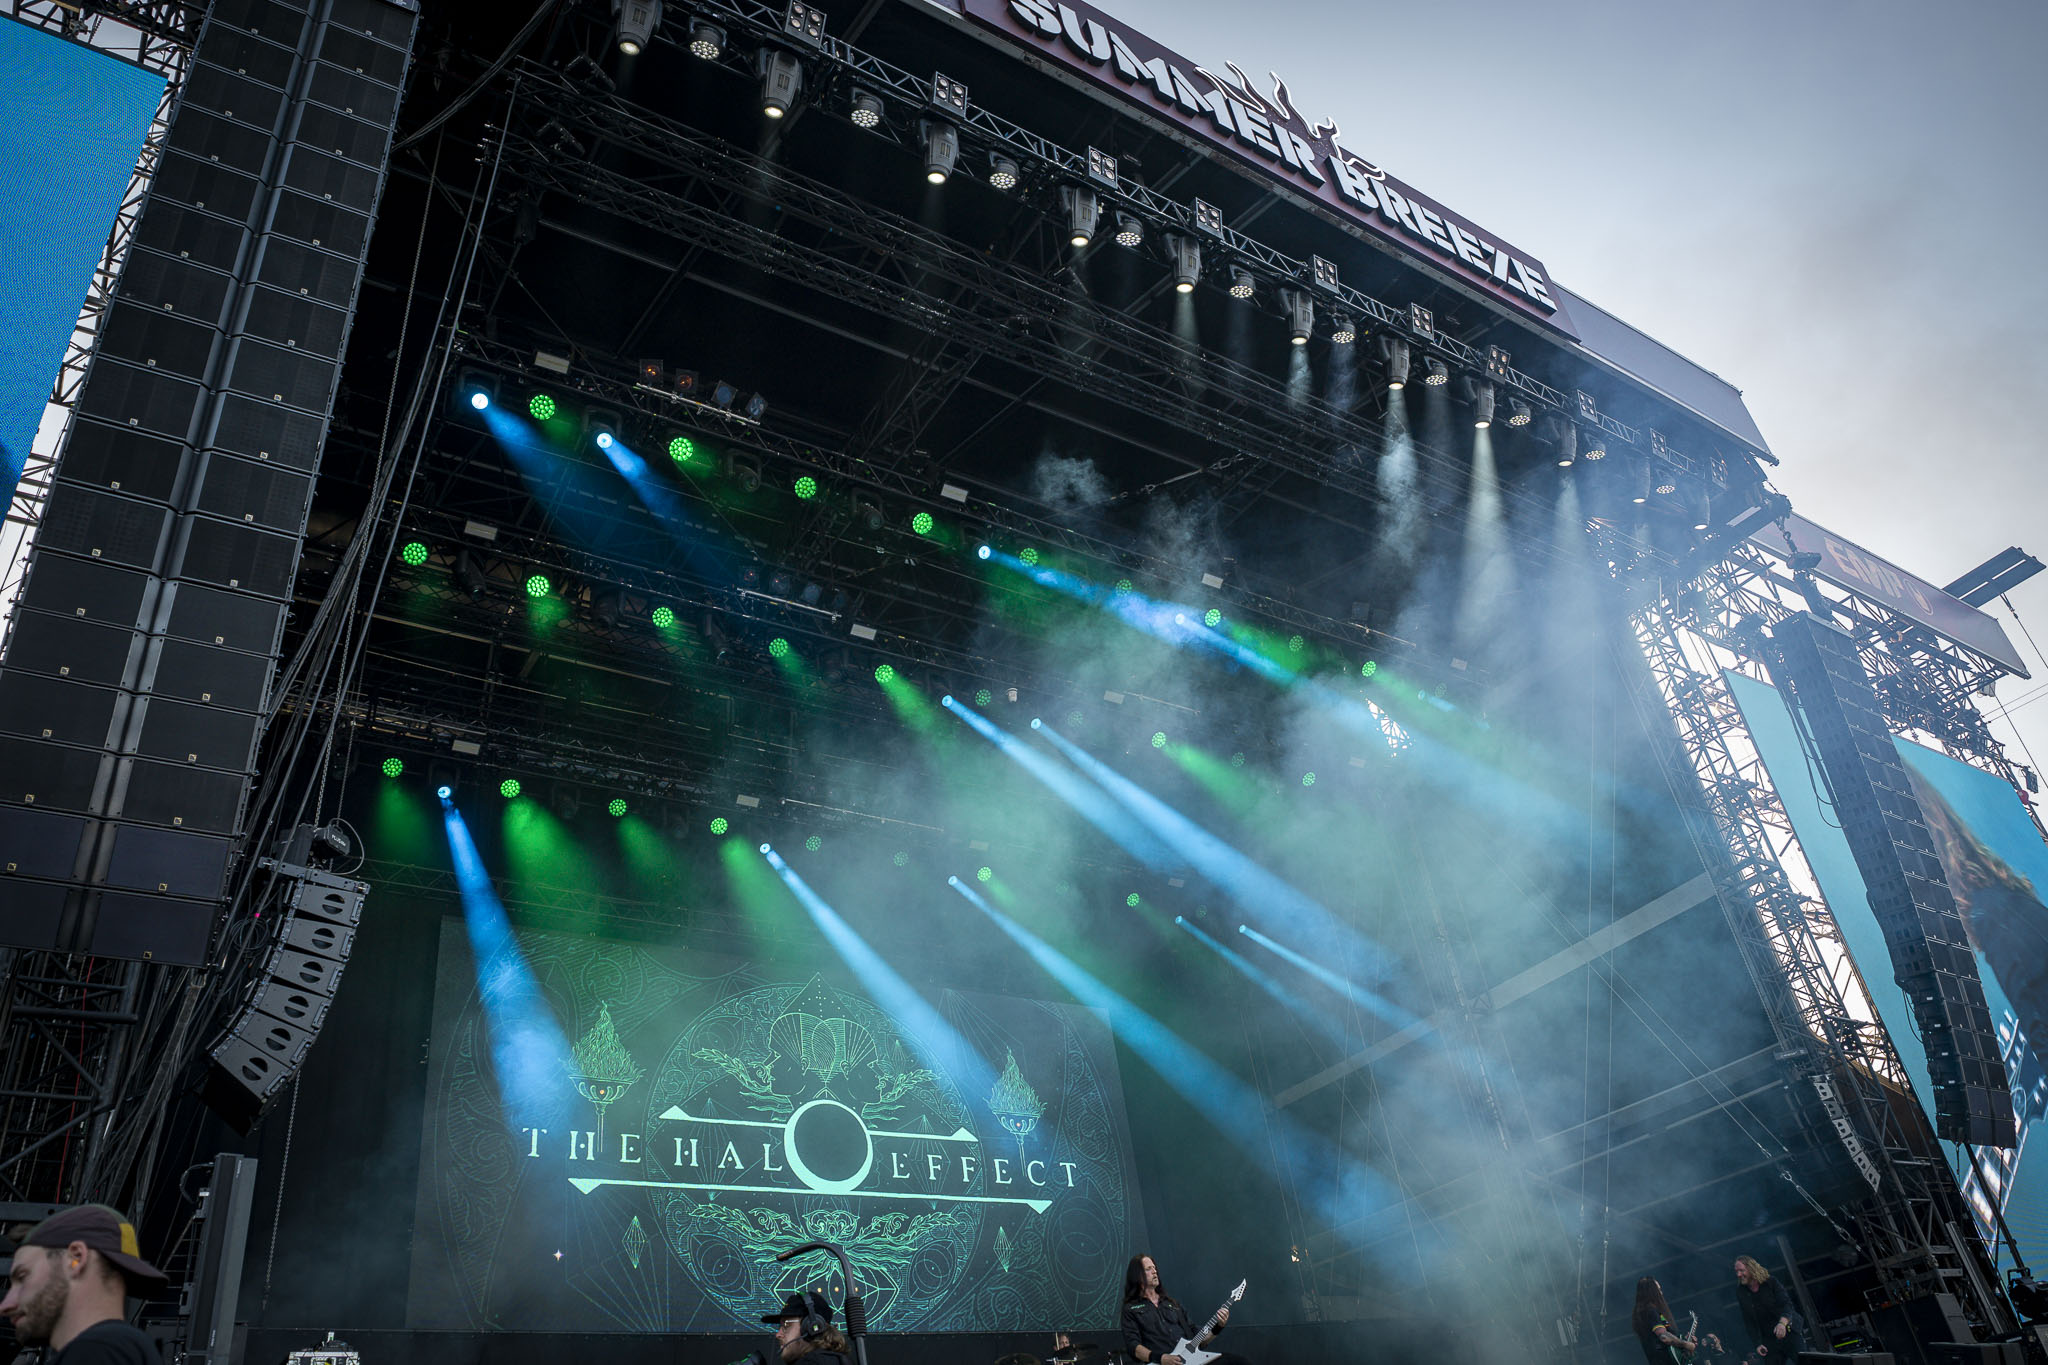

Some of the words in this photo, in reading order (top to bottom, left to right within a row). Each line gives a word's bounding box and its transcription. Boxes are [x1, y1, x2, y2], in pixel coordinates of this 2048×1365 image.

[1007, 0, 1326, 187] SUMMER
[1329, 154, 1557, 311] BREEZE
[522, 1128, 641, 1163] THE
[892, 1152, 1077, 1187] EFFECT
